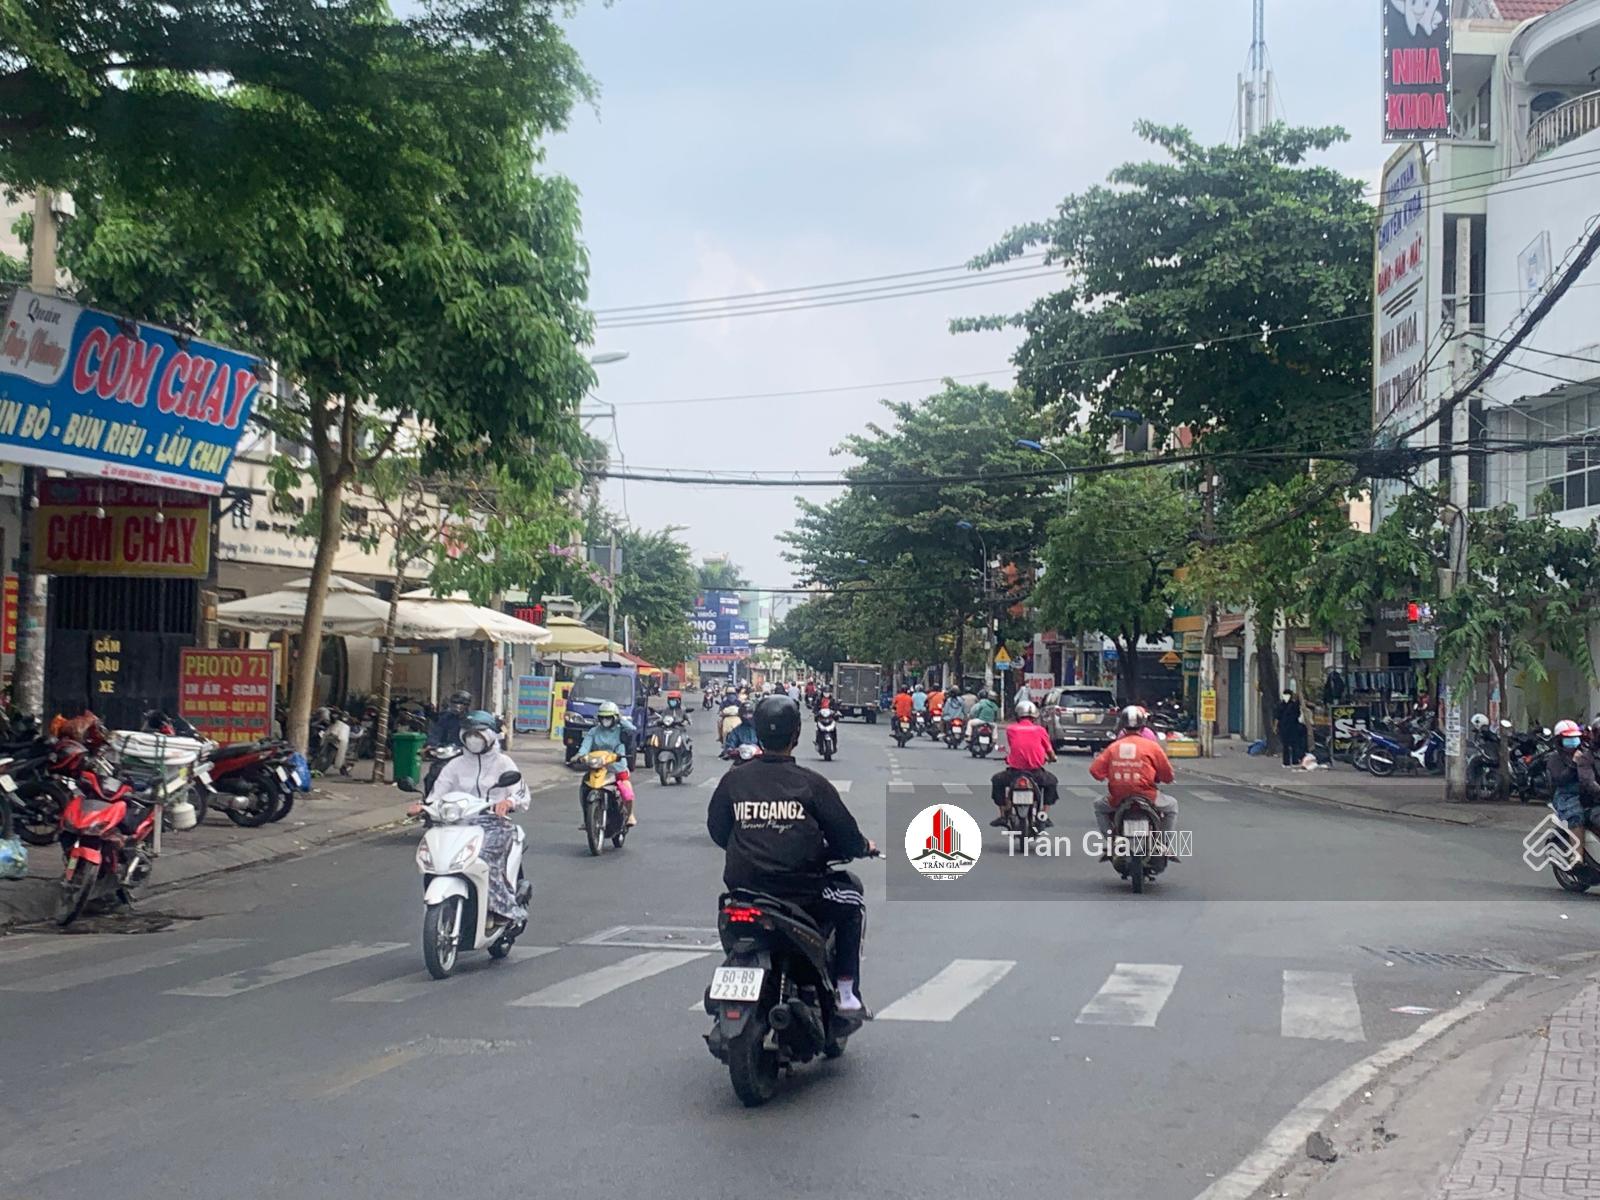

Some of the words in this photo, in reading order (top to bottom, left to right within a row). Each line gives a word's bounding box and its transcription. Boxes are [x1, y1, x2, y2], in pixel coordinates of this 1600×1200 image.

[1392, 47, 1443, 84] NHA
[1388, 92, 1448, 129] KHOA
[157, 351, 258, 430] CHAY
[62, 409, 106, 450] BÚN
[190, 440, 231, 474] CHAY
[48, 511, 113, 562] CƠM
[123, 516, 197, 565] CHAY
[687, 620, 717, 632] ONG
[95, 634, 121, 653] CẤM
[184, 655, 243, 677] PHOTO
[248, 657, 267, 677] 71
[99, 680, 115, 693] XE
[232, 684, 267, 696] SCAN
[733, 800, 806, 821] VIETGANGZ
